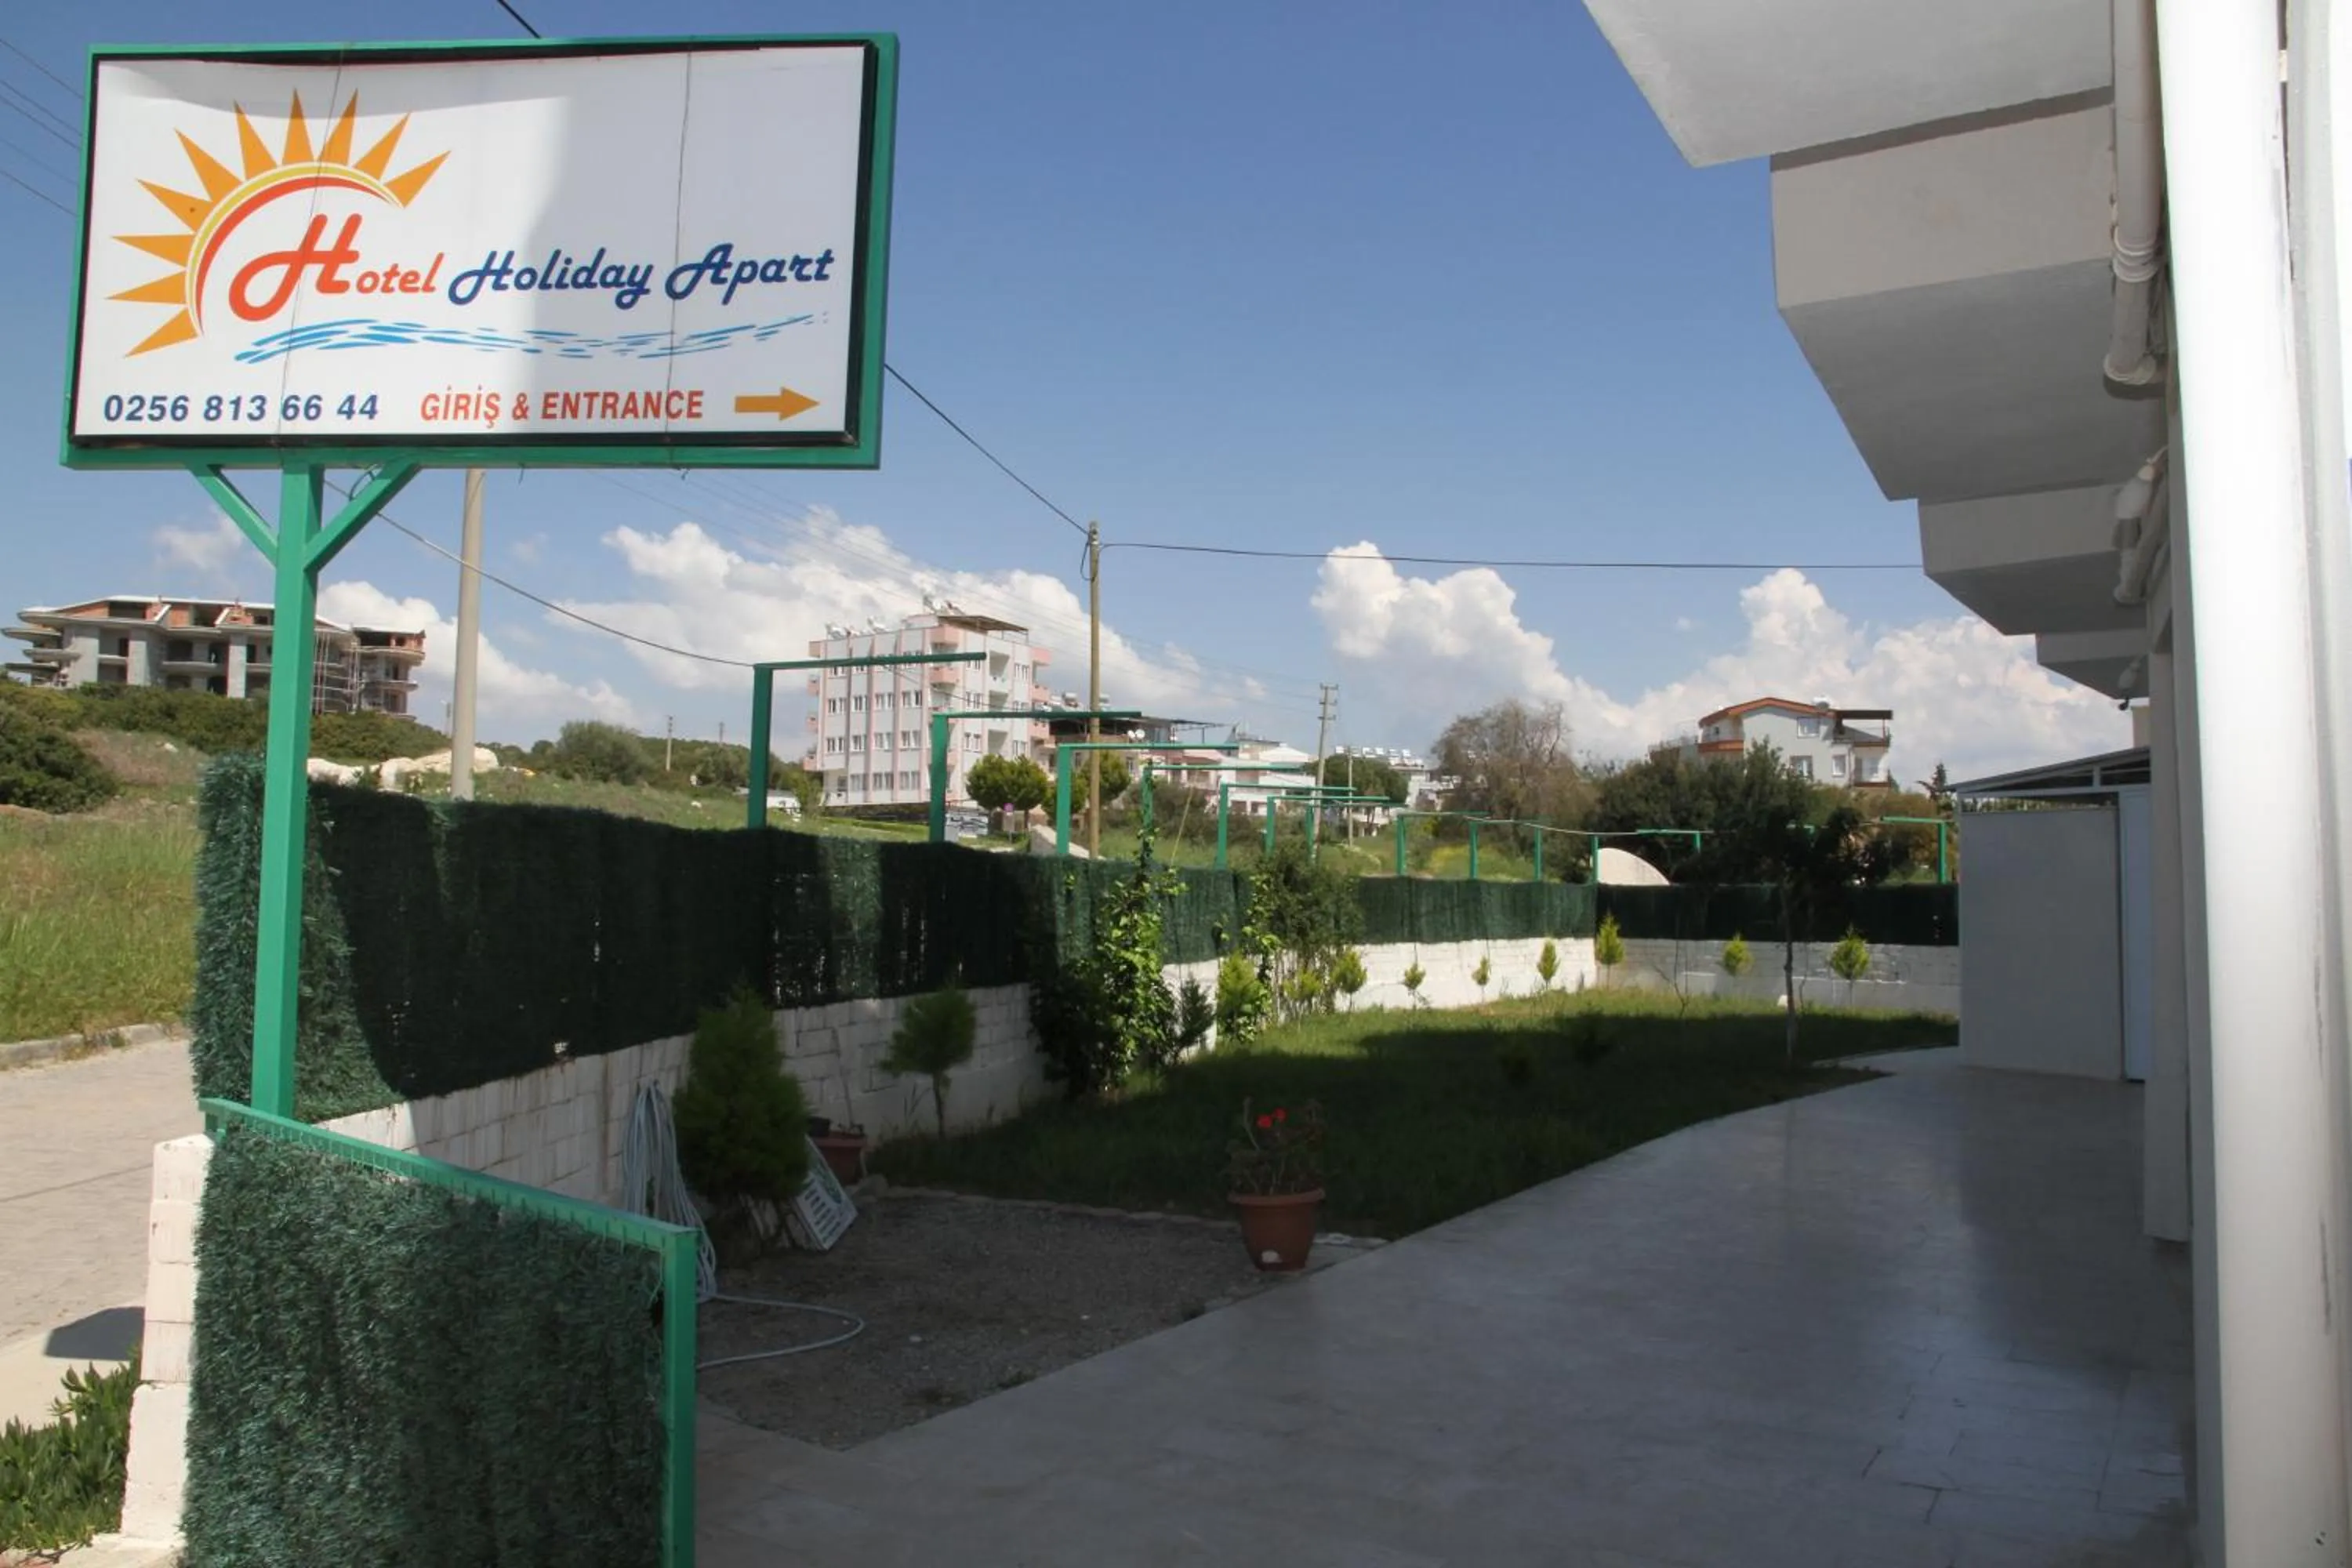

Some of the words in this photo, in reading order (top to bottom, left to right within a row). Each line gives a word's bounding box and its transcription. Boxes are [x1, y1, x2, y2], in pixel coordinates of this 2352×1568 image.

[228, 213, 445, 322] Hotel
[448, 247, 654, 310] Holiday
[664, 243, 835, 306] Apart
[103, 394, 190, 422] 0256
[203, 394, 267, 422] 813
[281, 394, 323, 422] 66
[337, 394, 379, 421] 44
[420, 384, 502, 429] GİRİŞ
[512, 392, 530, 420] &
[541, 390, 704, 421] ENTRANCE
